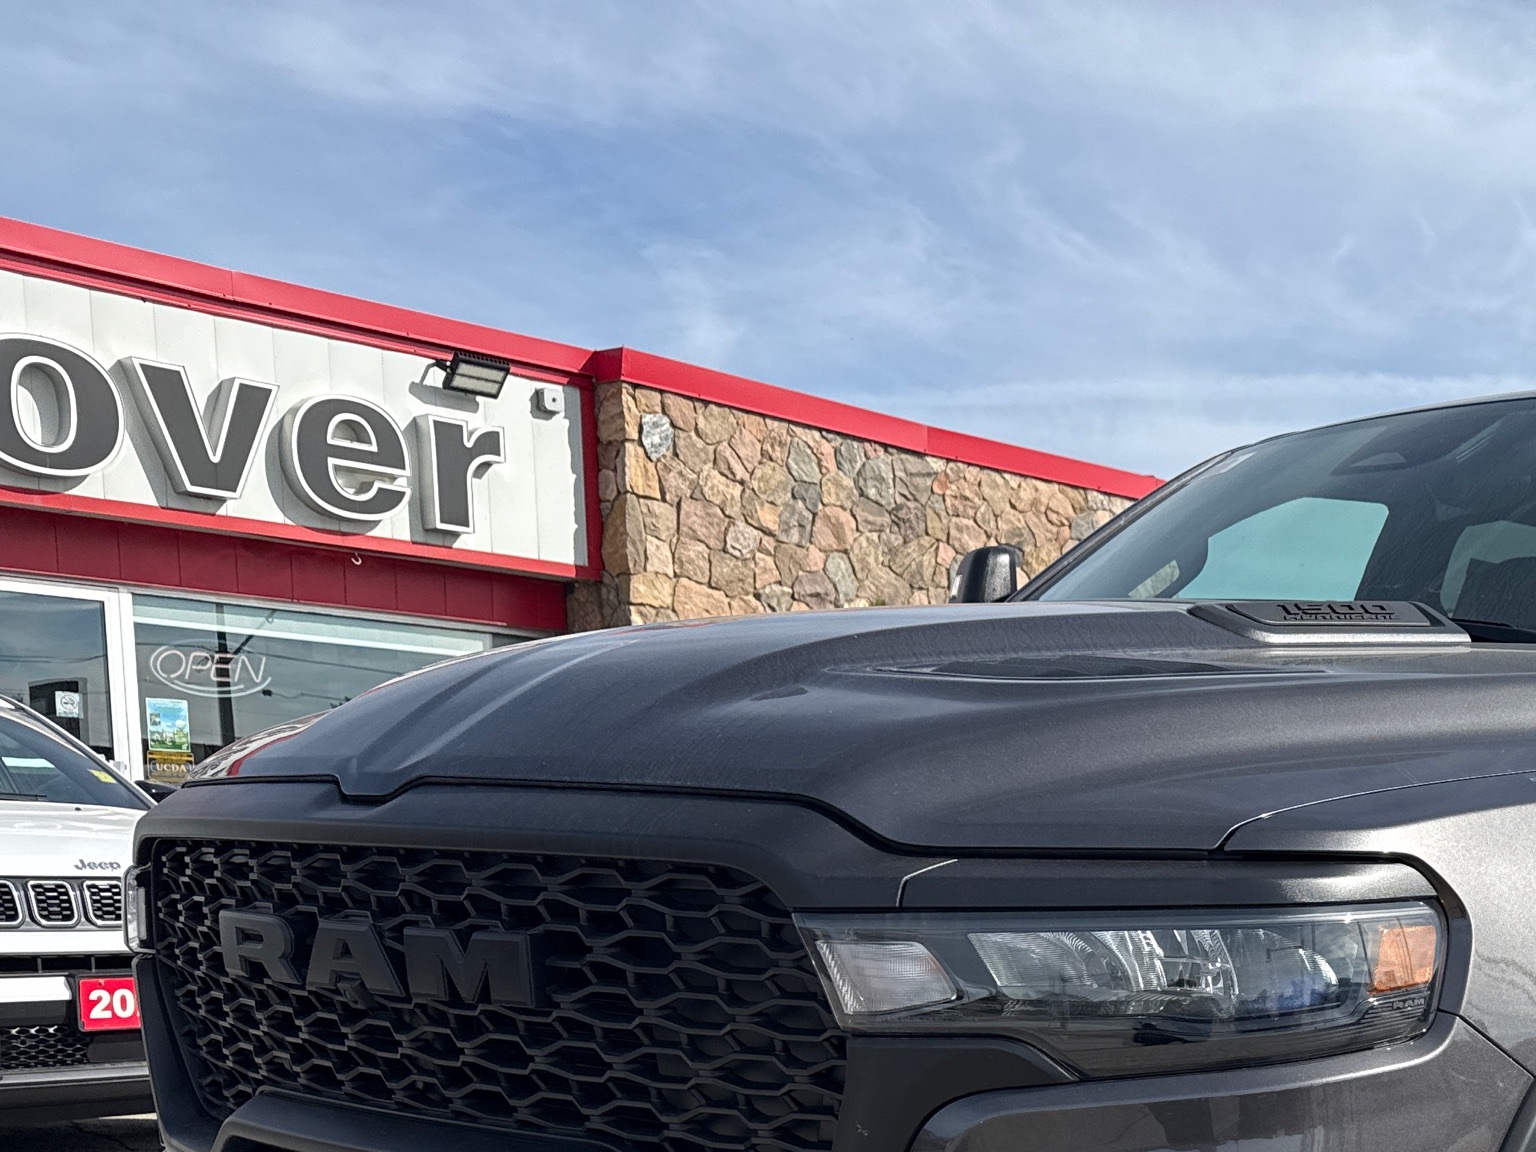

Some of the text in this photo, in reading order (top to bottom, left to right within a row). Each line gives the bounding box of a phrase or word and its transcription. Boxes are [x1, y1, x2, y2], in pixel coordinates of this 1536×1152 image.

[0, 332, 506, 534] over
[1276, 602, 1395, 616] 1500
[157, 649, 267, 683] OPEN
[156, 763, 187, 772] UCDA
[74, 859, 121, 871] Jeep
[218, 909, 535, 1008] RAM
[89, 988, 139, 1019] 20
[1393, 998, 1425, 1009] RAM
